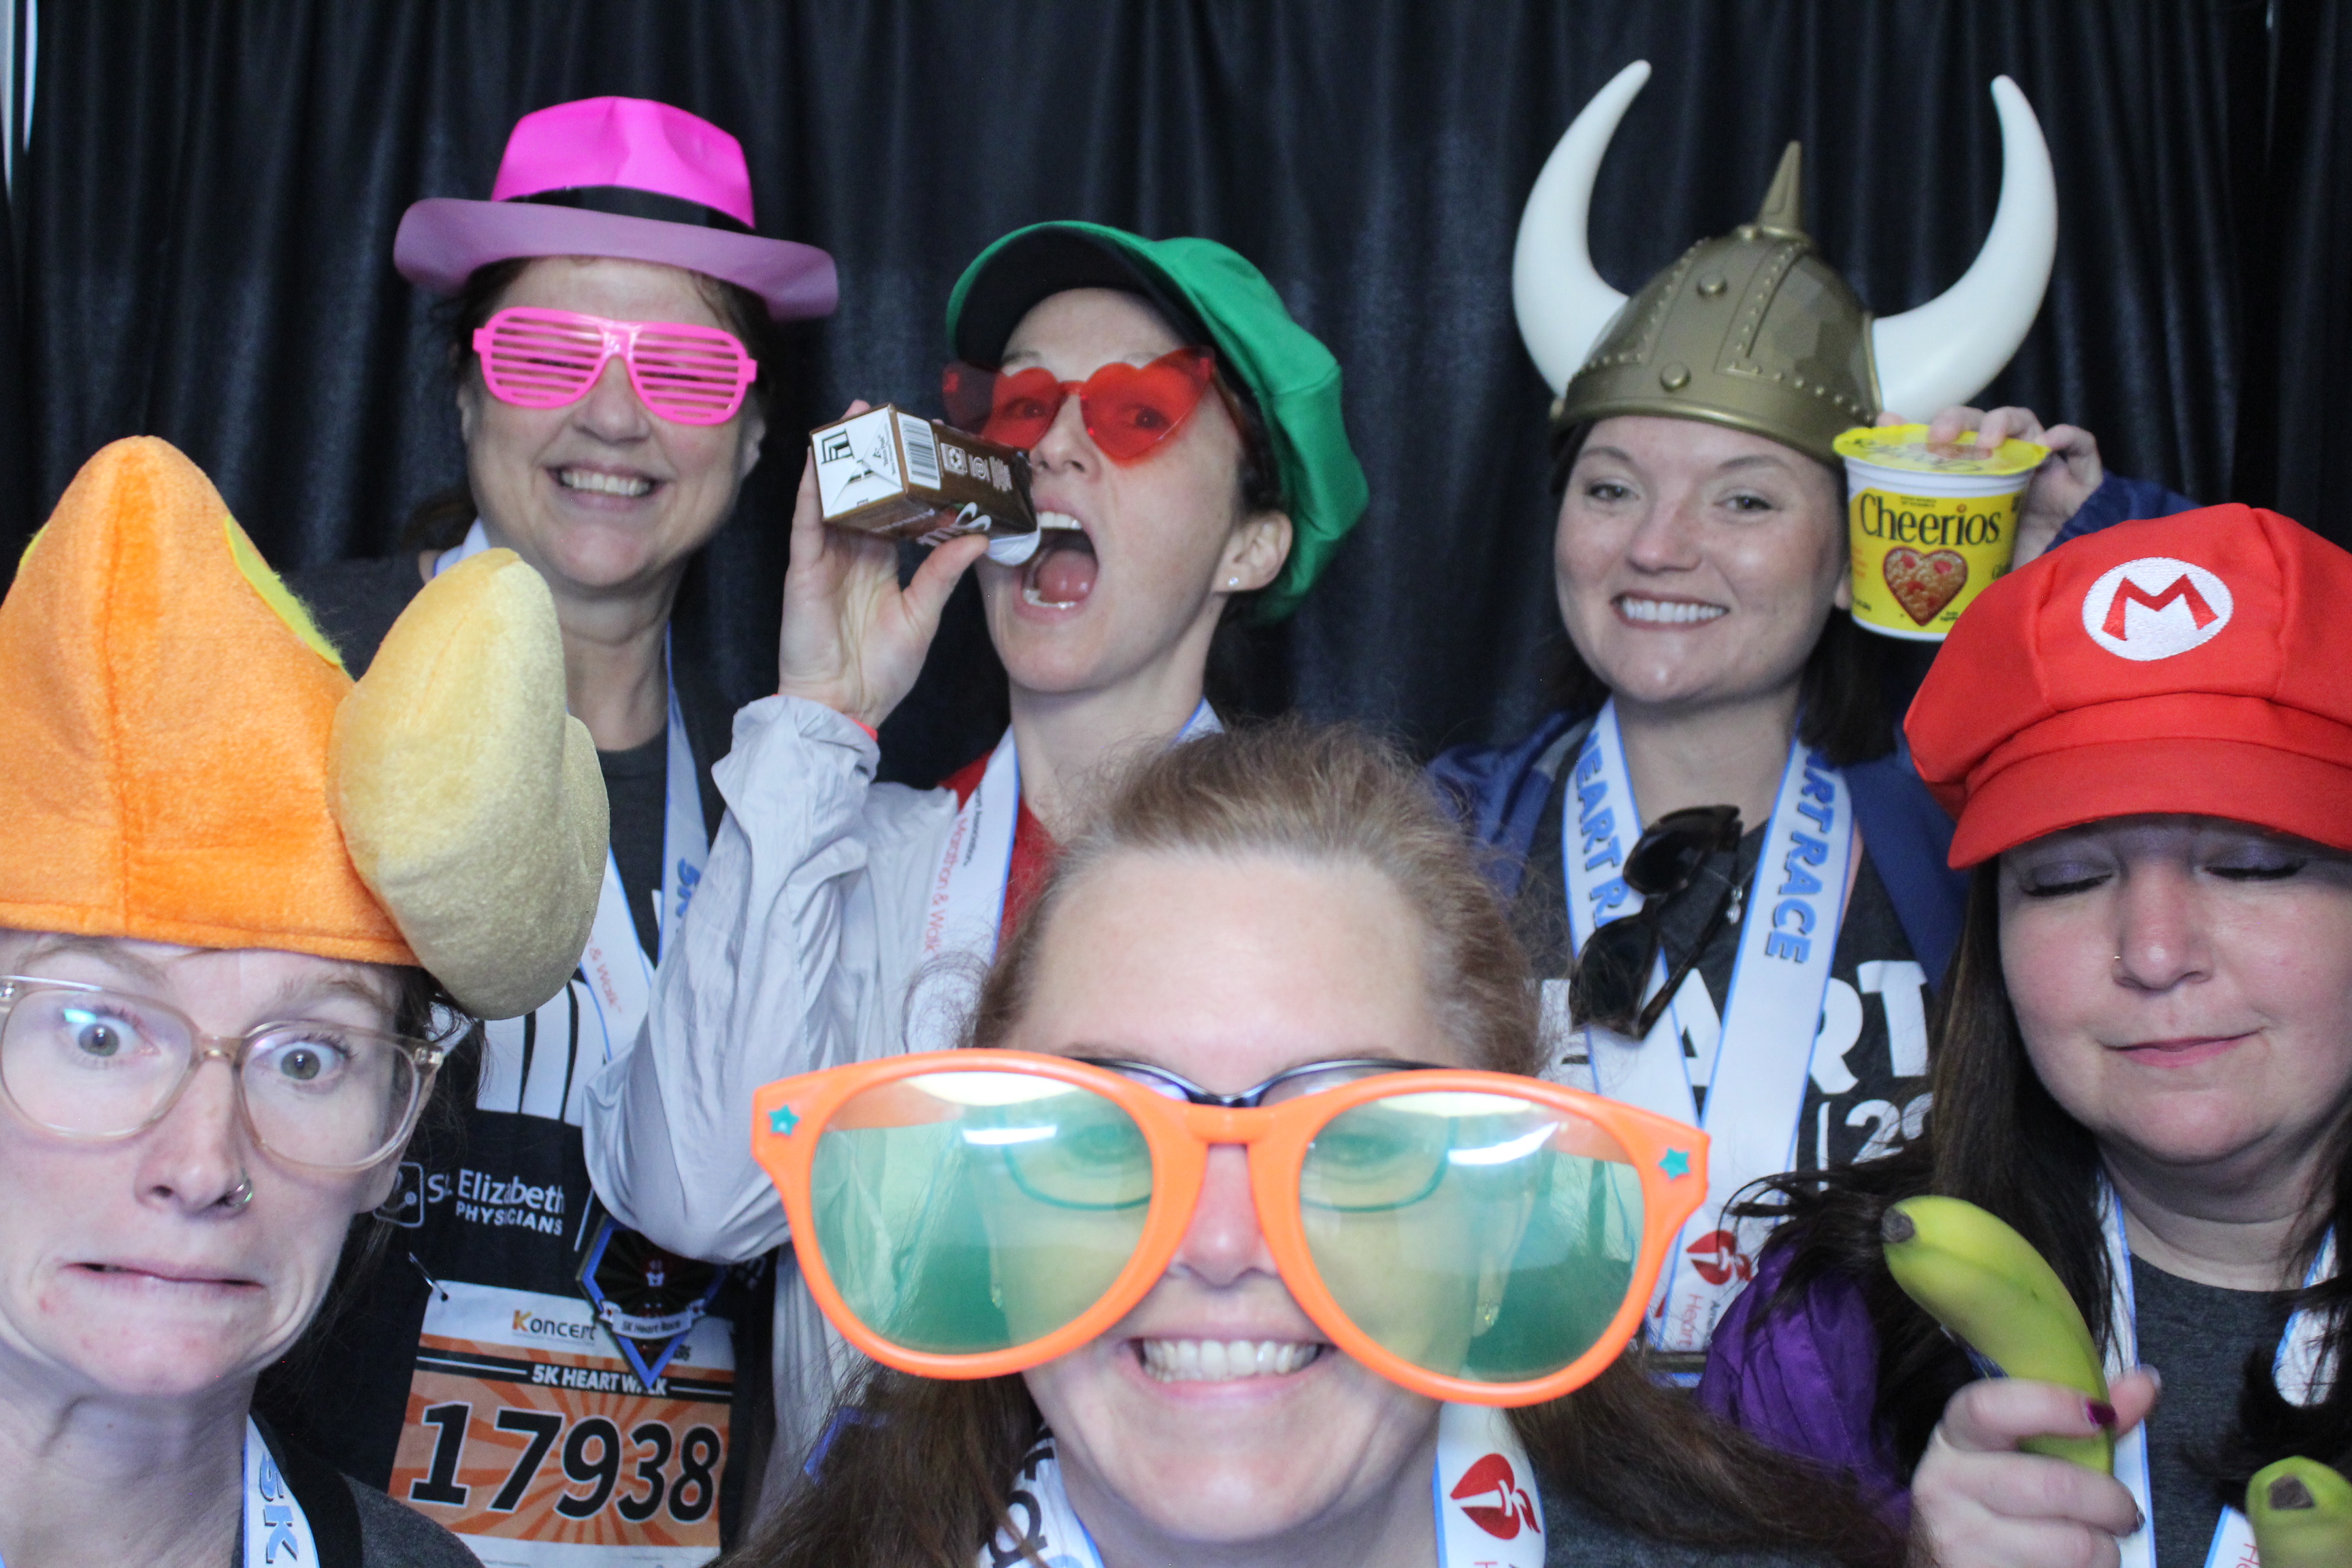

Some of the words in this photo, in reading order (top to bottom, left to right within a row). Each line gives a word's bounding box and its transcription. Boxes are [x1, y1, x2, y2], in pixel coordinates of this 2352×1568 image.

[1861, 492, 2002, 546] Cheerios
[2101, 573, 2219, 642] M
[932, 892, 949, 906] &
[1765, 830, 1835, 964] RACE
[924, 909, 946, 953] Walk
[455, 1200, 564, 1236] PHYSICIANS
[512, 1309, 597, 1341] Koncert
[532, 1362, 559, 1386] 5K
[561, 1367, 620, 1392] HEART
[408, 1400, 721, 1524] 17938
